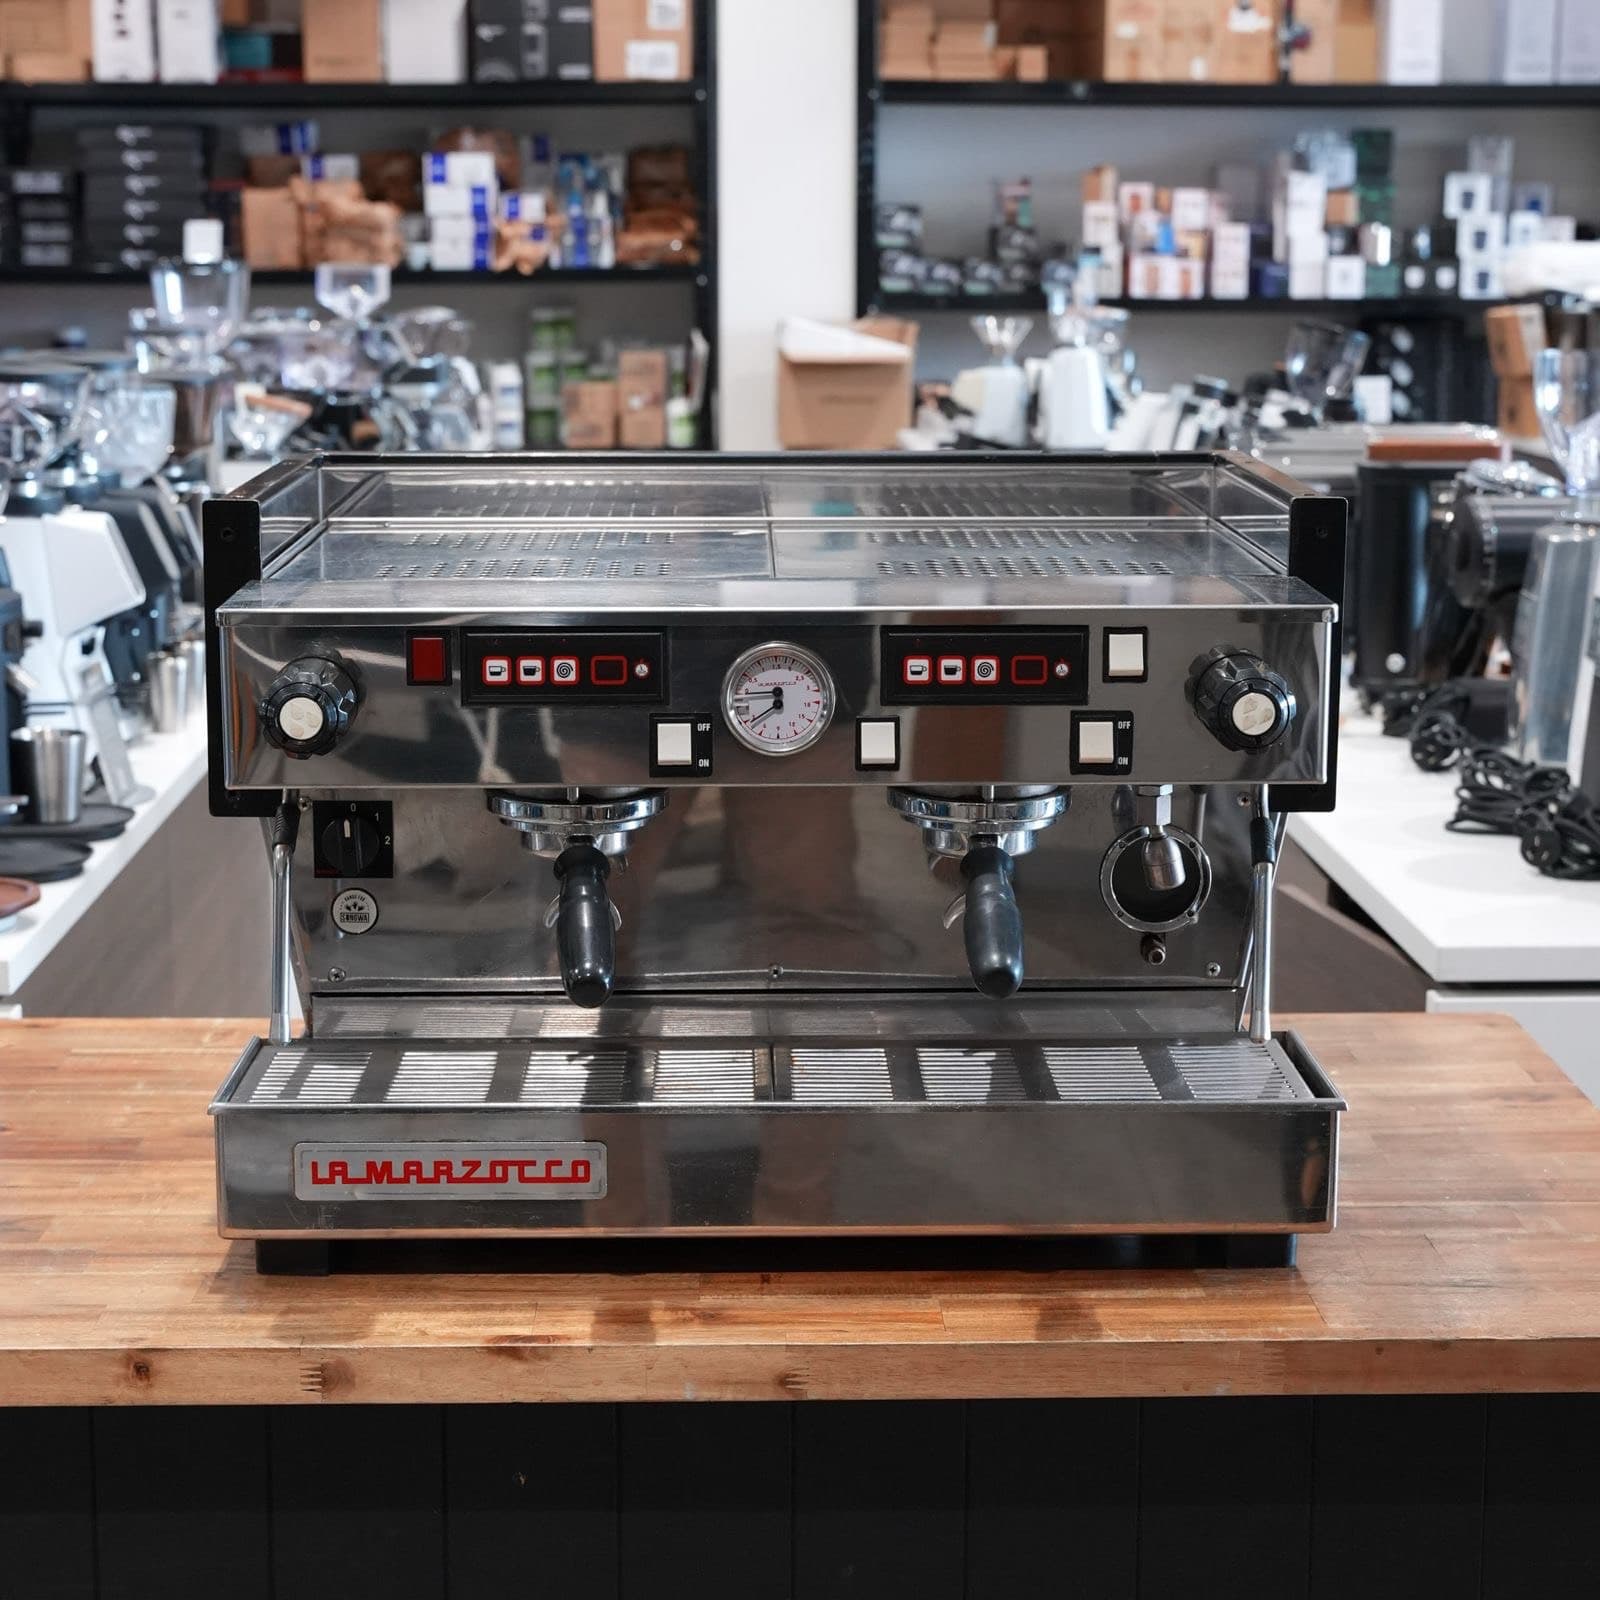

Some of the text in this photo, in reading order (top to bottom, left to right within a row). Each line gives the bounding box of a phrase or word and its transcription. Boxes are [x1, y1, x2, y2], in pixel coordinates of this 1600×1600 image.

[697, 723, 711, 731] OFF
[1118, 721, 1131, 729] OFF
[698, 758, 709, 767] ON
[1118, 757, 1129, 765] ON
[350, 803, 357, 812] 0
[374, 812, 379, 821] 1
[384, 835, 391, 845] 2
[311, 1160, 591, 1184] LA MARZOCCO
